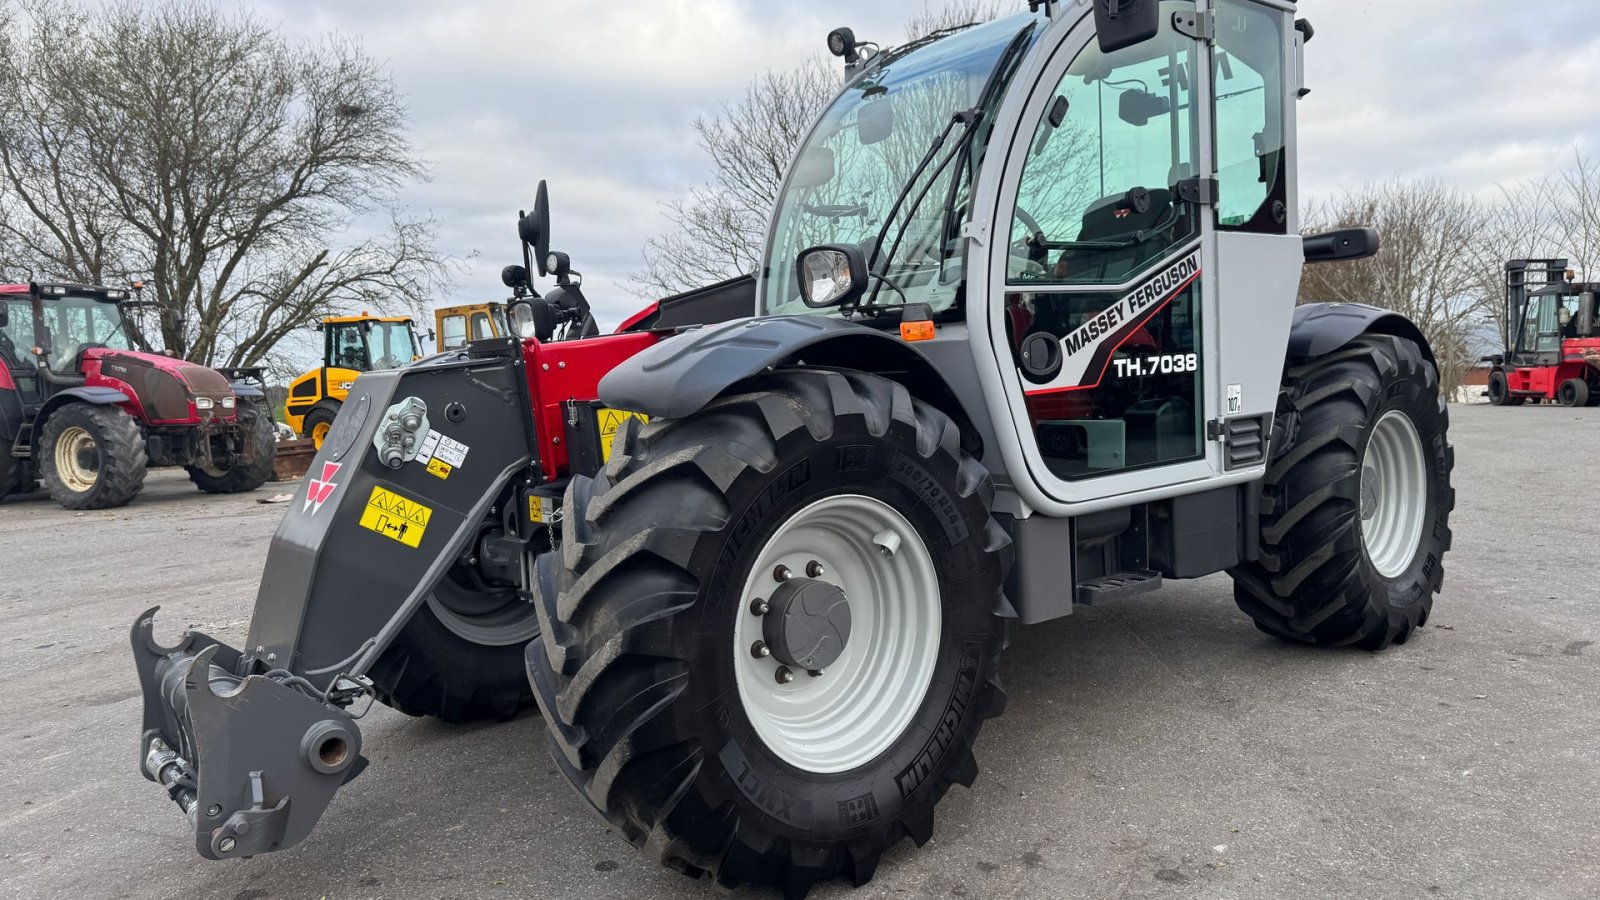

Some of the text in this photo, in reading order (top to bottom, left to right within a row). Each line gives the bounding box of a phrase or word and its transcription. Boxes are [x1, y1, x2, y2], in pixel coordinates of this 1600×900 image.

[1065, 254, 1198, 356] MASSEY FERGUSON
[338, 381, 354, 390] JC
[1113, 353, 1198, 378] TH.7038
[901, 673, 974, 797] MICHELIN
